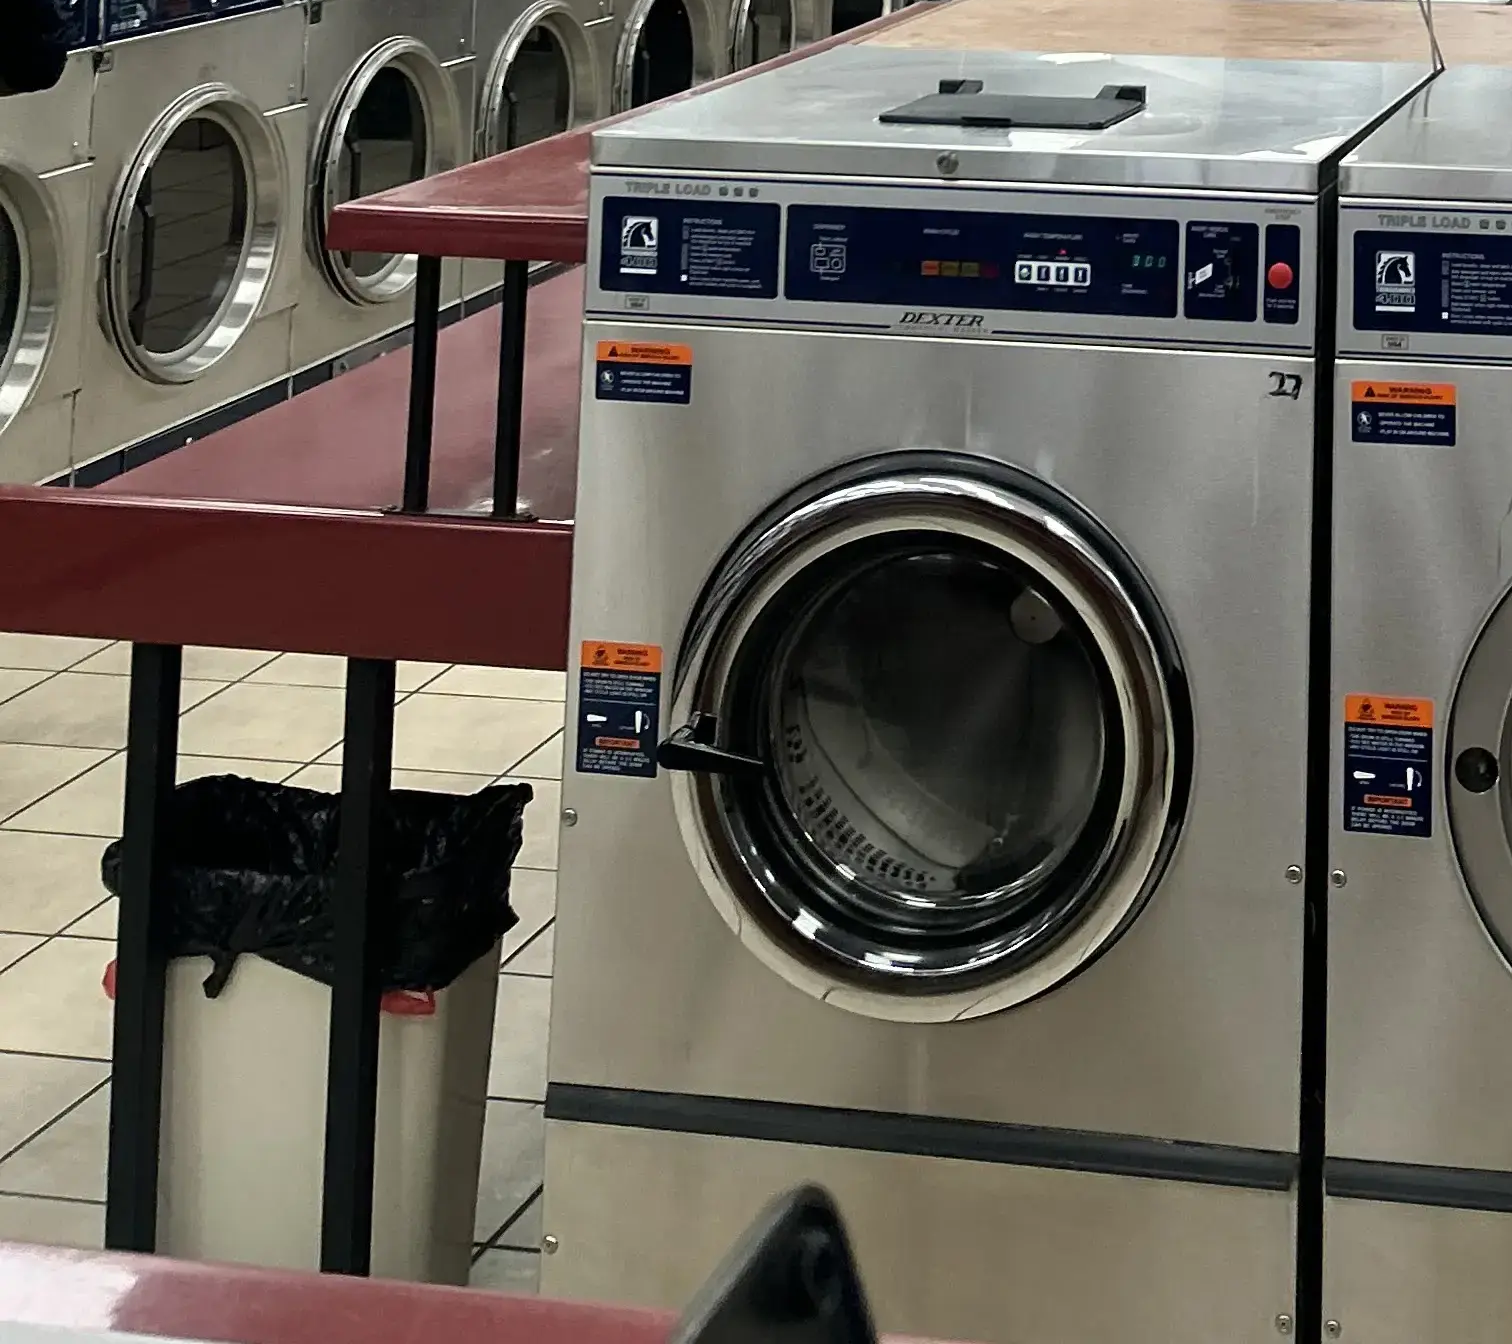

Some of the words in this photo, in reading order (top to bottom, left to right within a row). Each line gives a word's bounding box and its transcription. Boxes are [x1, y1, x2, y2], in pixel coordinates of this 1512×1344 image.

[625, 182, 670, 194] TRIPLE
[675, 183, 711, 196] LOAD
[1378, 214, 1427, 228] TRIPLE
[1432, 216, 1471, 229] LOAD
[899, 311, 984, 327] DEXTER
[1268, 370, 1303, 401] 27
